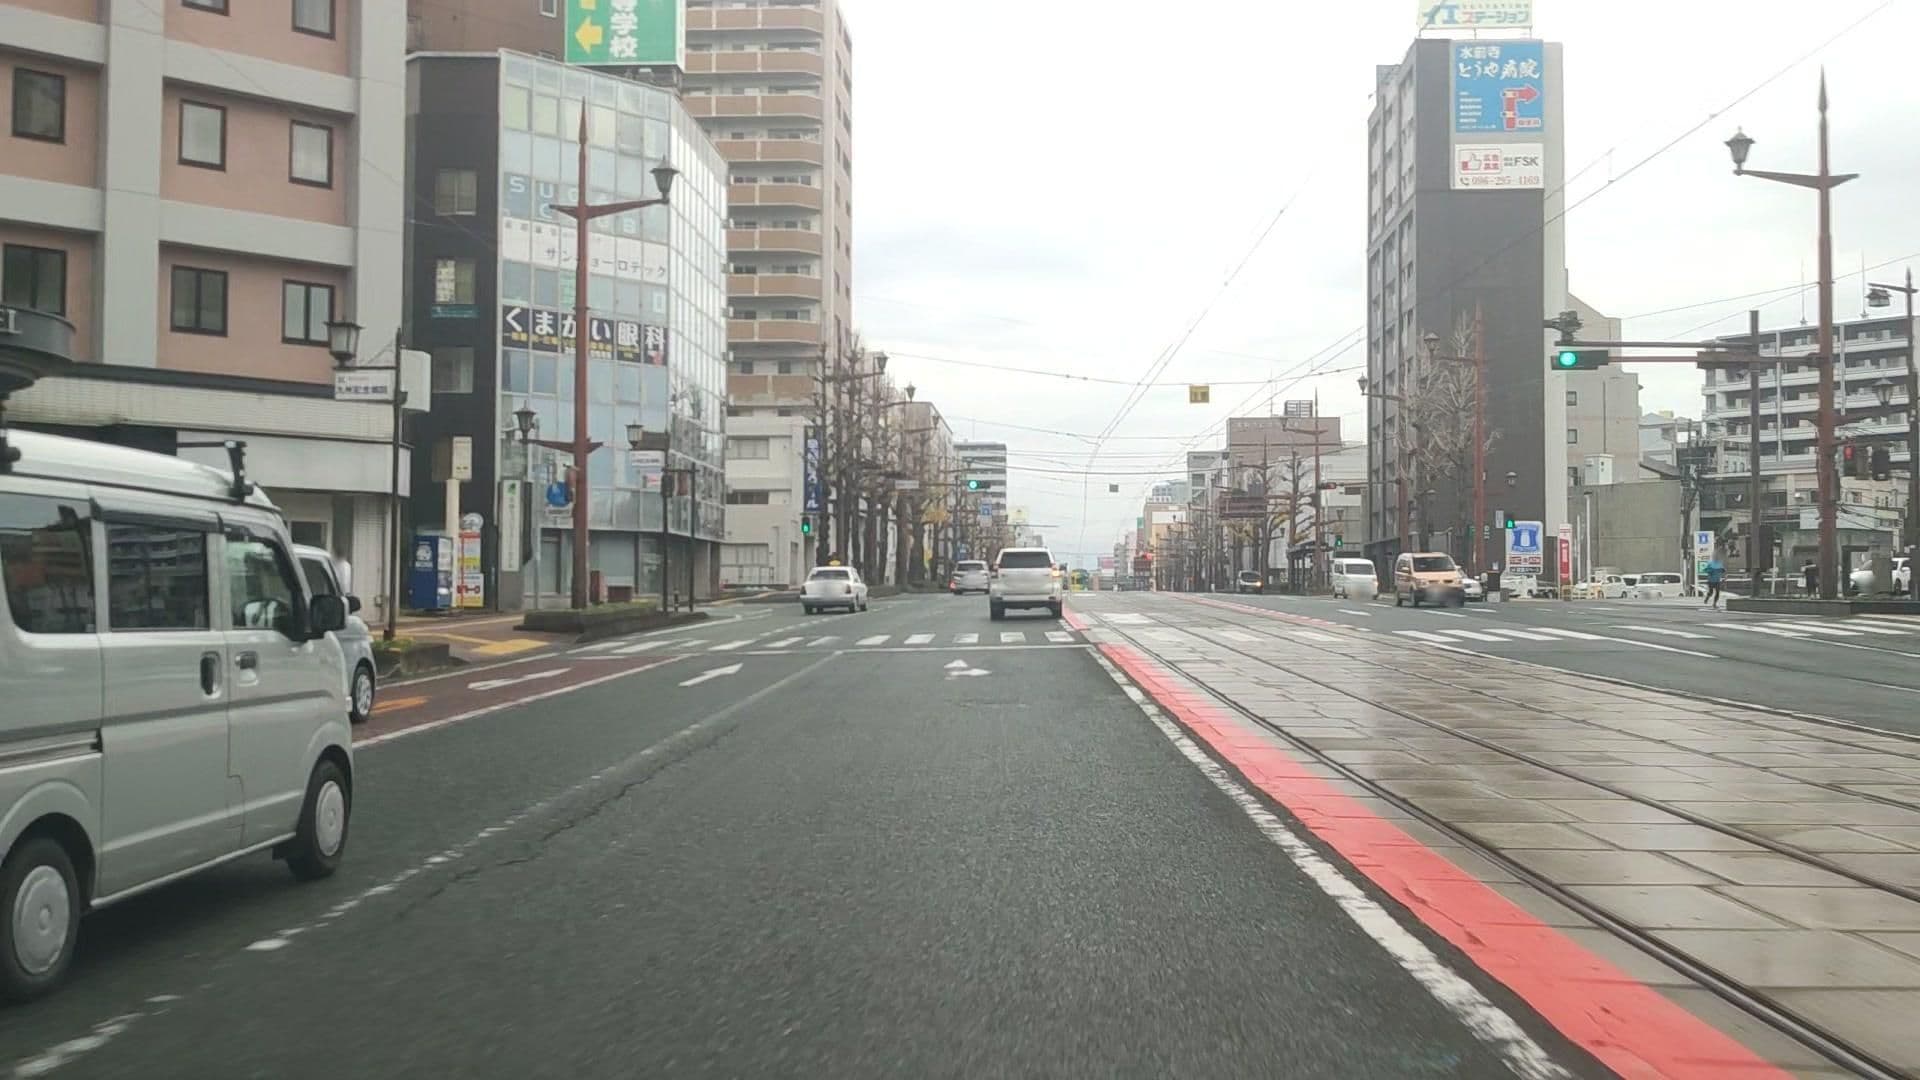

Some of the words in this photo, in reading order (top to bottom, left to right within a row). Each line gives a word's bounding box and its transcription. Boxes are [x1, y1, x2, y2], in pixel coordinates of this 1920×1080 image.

[610, 0, 638, 58] 学校
[1458, 59, 1541, 80] とうや病院
[1513, 156, 1539, 167] FSK
